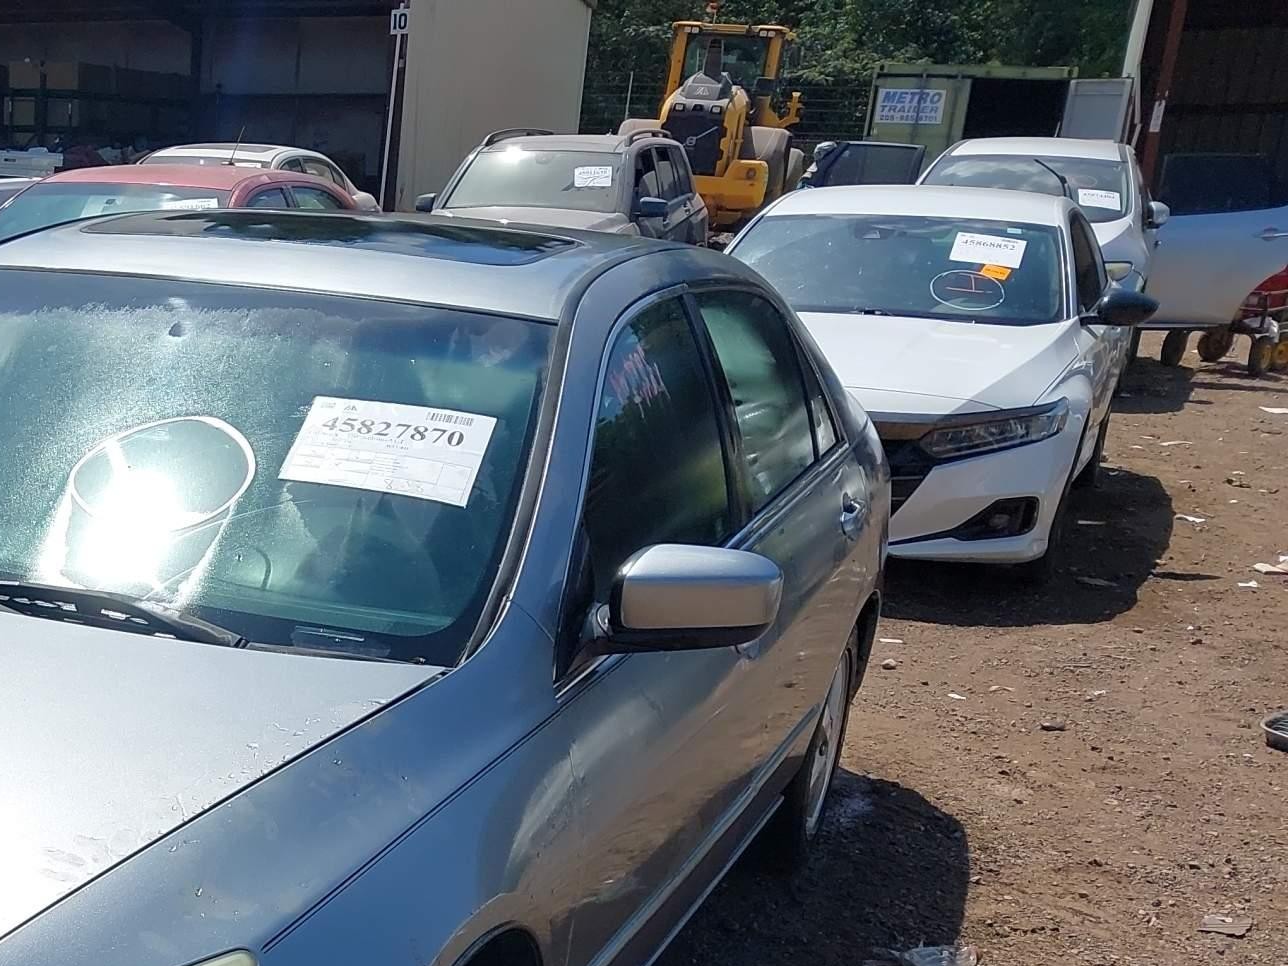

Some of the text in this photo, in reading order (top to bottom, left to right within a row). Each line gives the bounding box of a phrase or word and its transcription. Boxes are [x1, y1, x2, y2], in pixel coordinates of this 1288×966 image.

[393, 13, 408, 30] 10
[882, 91, 943, 105] METRO
[879, 105, 938, 114] TRAILER
[321, 417, 464, 447] 45827870
